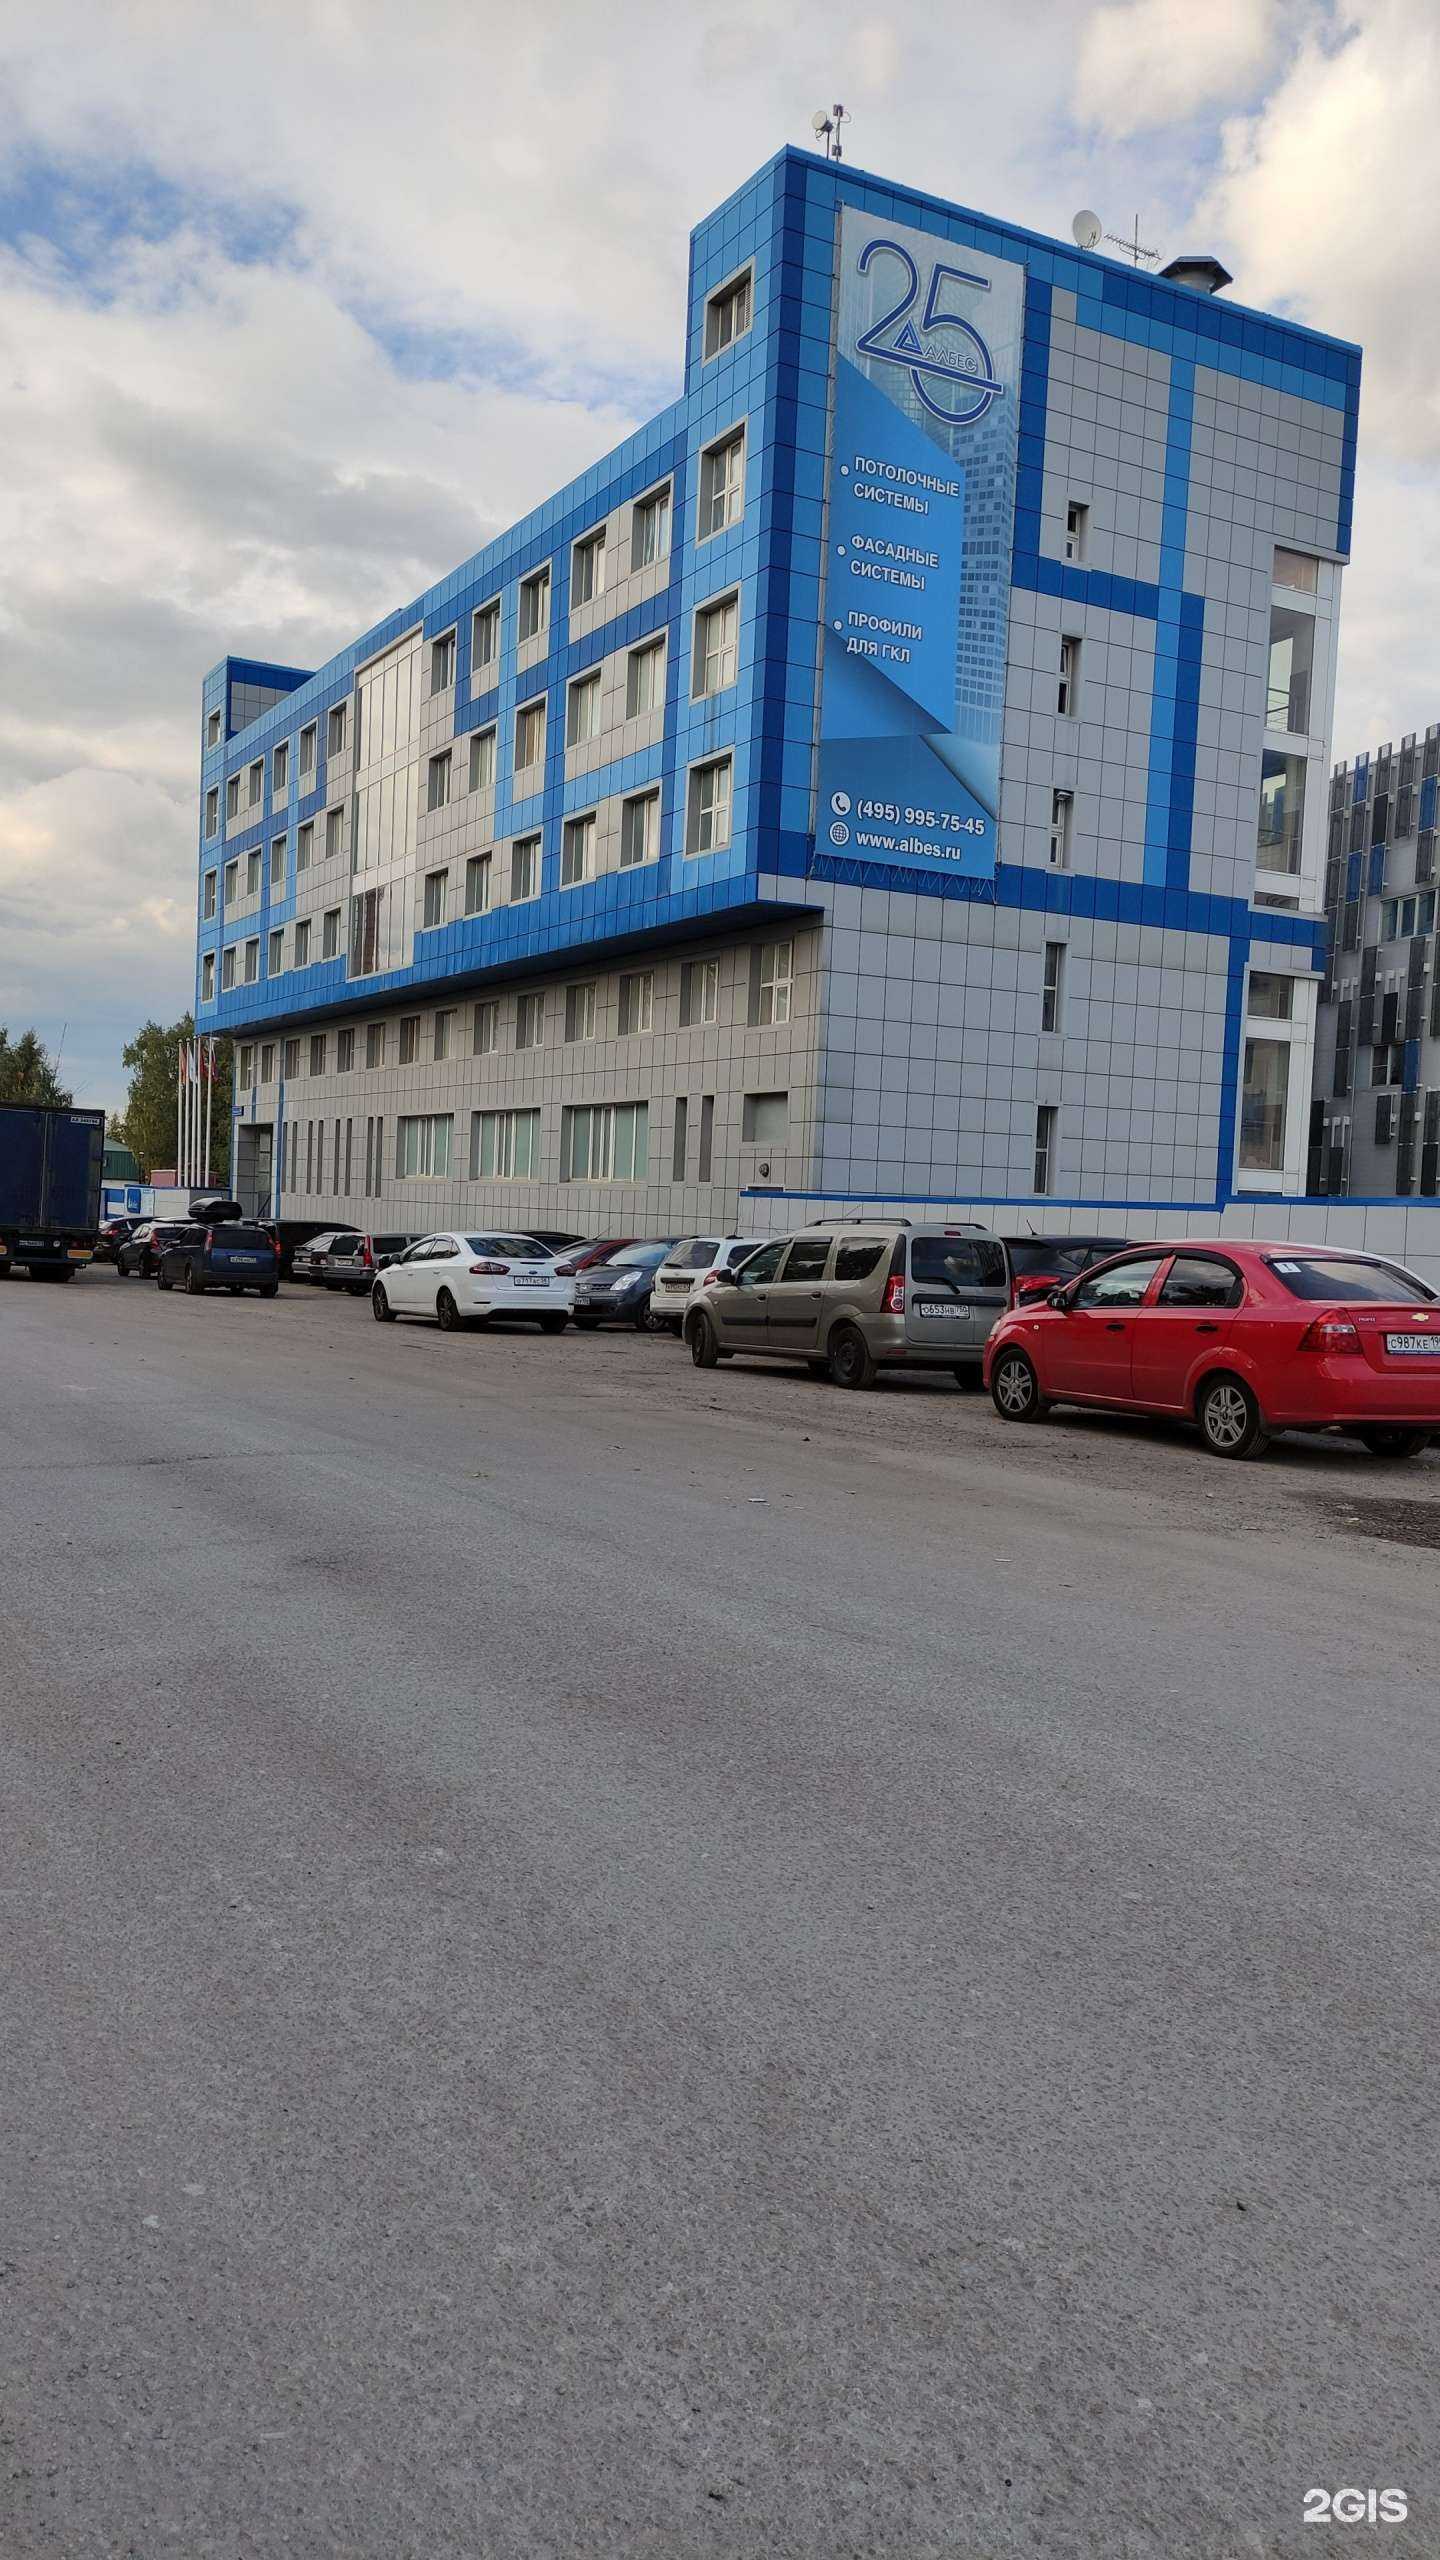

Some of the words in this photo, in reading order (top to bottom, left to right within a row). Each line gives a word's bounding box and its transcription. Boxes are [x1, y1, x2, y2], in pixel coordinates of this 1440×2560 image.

[857, 239, 1003, 425] 25
[854, 456, 960, 497] ПОТОЛОЧНЫЕ
[853, 483, 929, 515] СИСТЕМЫ
[851, 534, 939, 568] ФАСАДНЫЕ
[850, 560, 925, 590] СИСТЕМЫ
[848, 611, 922, 640] ПРОФИЛИ
[847, 637, 878, 656] ДЛЯ
[882, 643, 911, 664] ГКЛ
[857, 800, 900, 825] (495)
[904, 807, 985, 835] 995-75-45
[856, 832, 961, 860] www.albes.ru
